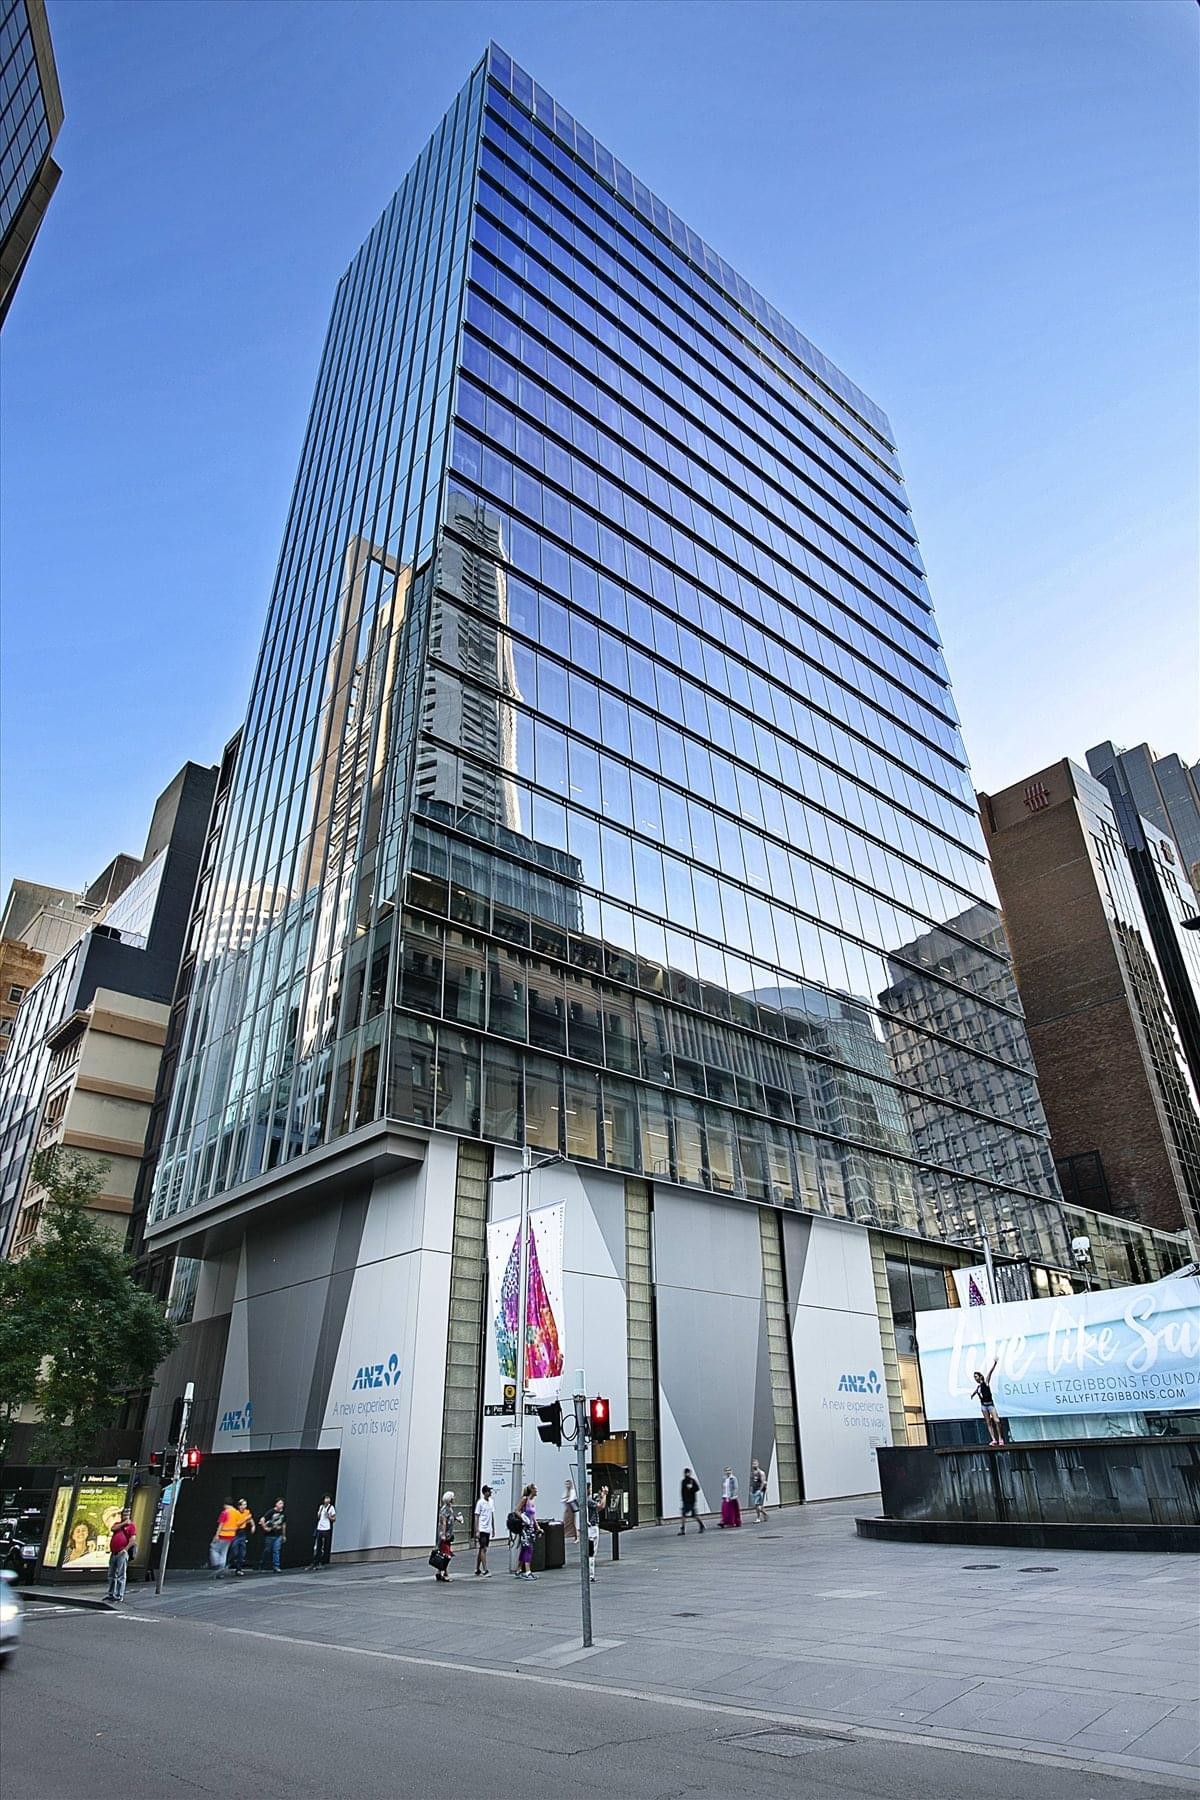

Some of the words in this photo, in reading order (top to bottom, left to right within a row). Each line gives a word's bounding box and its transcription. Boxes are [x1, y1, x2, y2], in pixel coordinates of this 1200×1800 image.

[948, 1309, 1036, 1397] Live
[1048, 1303, 1119, 1376] like
[1123, 1296, 1200, 1374] Sa
[351, 1364, 384, 1390] ANZ
[838, 1374, 866, 1393] ANZ
[1003, 1382, 1040, 1395] SALLY
[1045, 1375, 1137, 1392] FITZGIBBONS
[1141, 1370, 1200, 1387] FOUND
[822, 1397, 829, 1410] A
[829, 1400, 845, 1411] new
[846, 1400, 885, 1413] experience
[1055, 1388, 1186, 1404] SALLYFITZGIBBONS.COM
[332, 1401, 339, 1417] A
[340, 1402, 357, 1416] new
[357, 1397, 400, 1417] experience
[218, 1410, 242, 1431] ANZ
[350, 1420, 356, 1435] is
[358, 1421, 369, 1435] on
[370, 1418, 379, 1434] its
[850, 1416, 862, 1427] on
